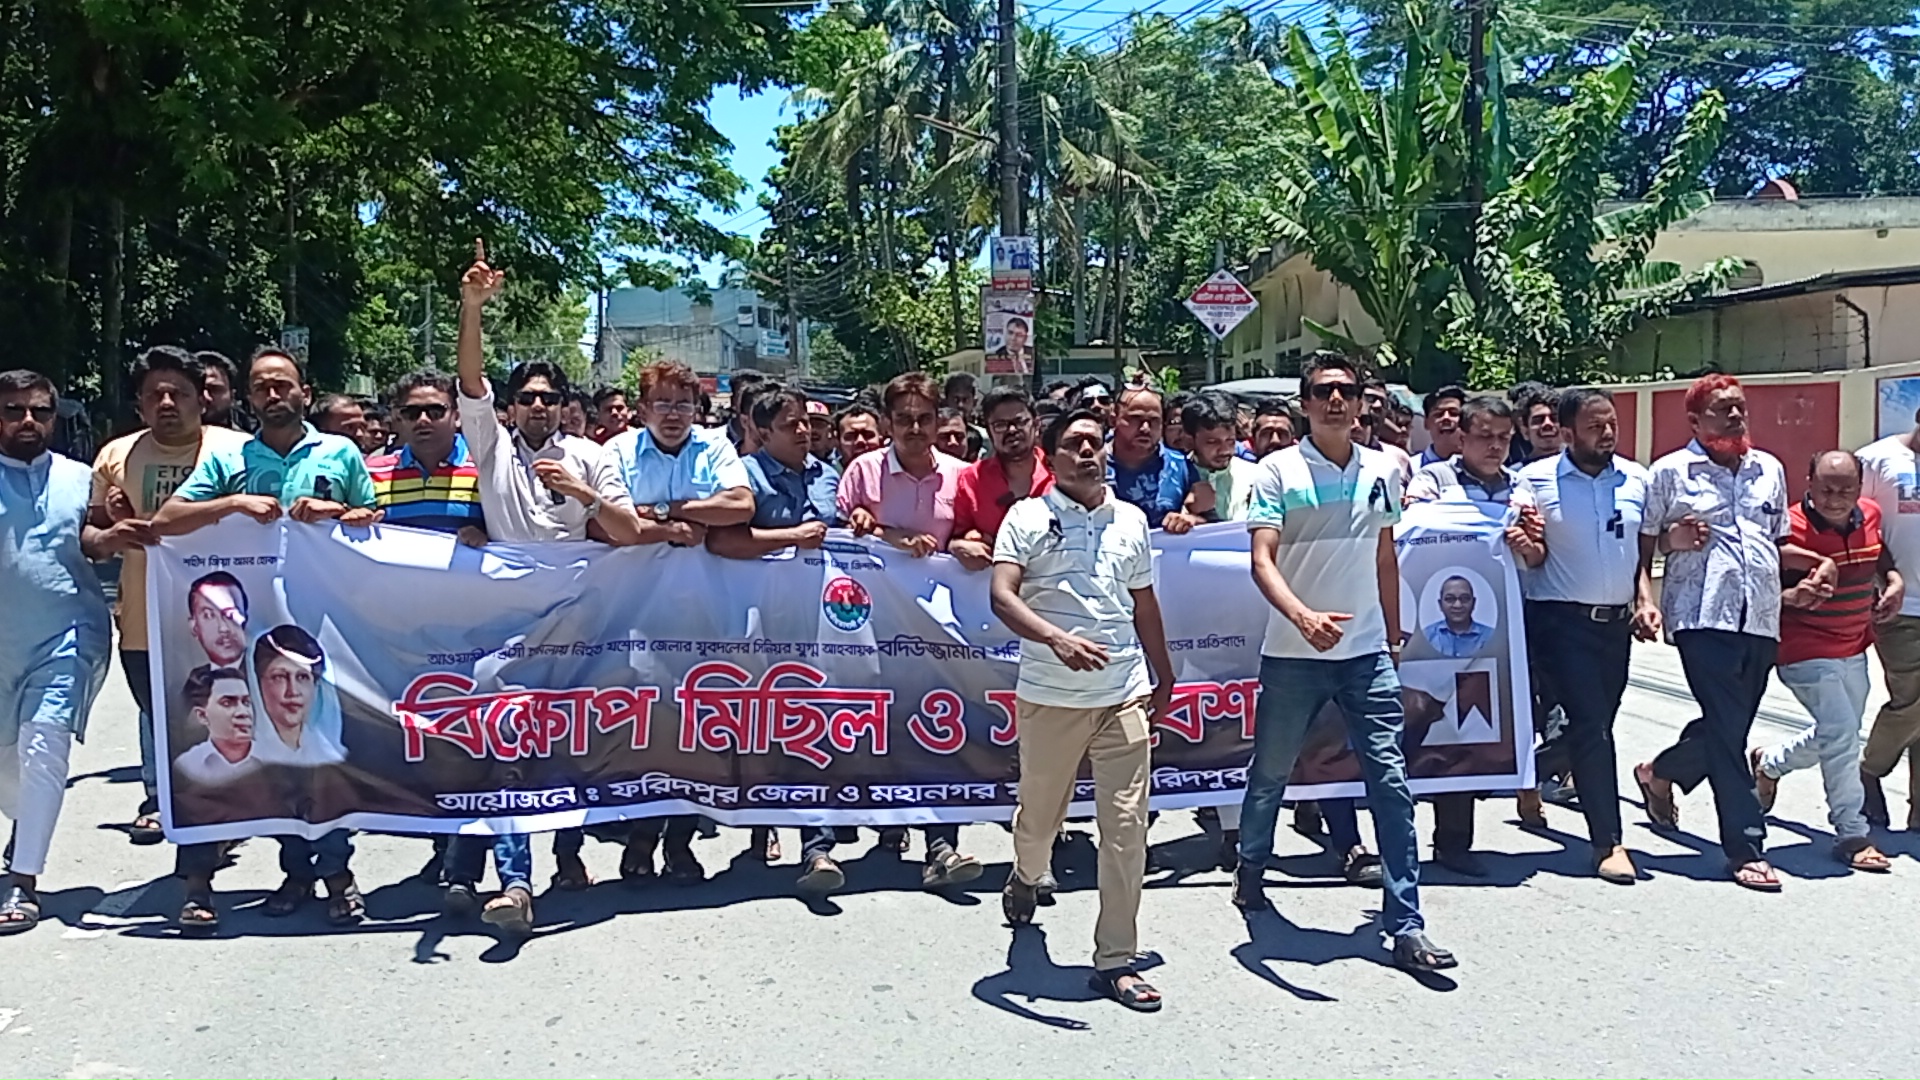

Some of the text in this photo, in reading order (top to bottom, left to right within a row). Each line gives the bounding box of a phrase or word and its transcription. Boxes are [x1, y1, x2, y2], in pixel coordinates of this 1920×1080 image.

[572, 643, 602, 657] নিহত
[607, 640, 645, 653] যশোর
[650, 640, 692, 653] জেলার
[696, 640, 750, 655] যুবদলের
[754, 639, 791, 653] সিনিয়র
[796, 643, 819, 658] যুগ্ম
[879, 636, 986, 660] বদিউজ্জামান
[1197, 634, 1246, 649] প্রতিবাদে
[676, 662, 893, 769] মিছিল
[908, 689, 967, 756] ও
[436, 787, 578, 812] আয়োজনে
[608, 772, 740, 806] ফরিদপুর
[747, 785, 832, 804] জেলা
[837, 786, 860, 803] ও
[869, 785, 997, 804] মহানগর
[1150, 766, 1249, 789] রিদপুর
